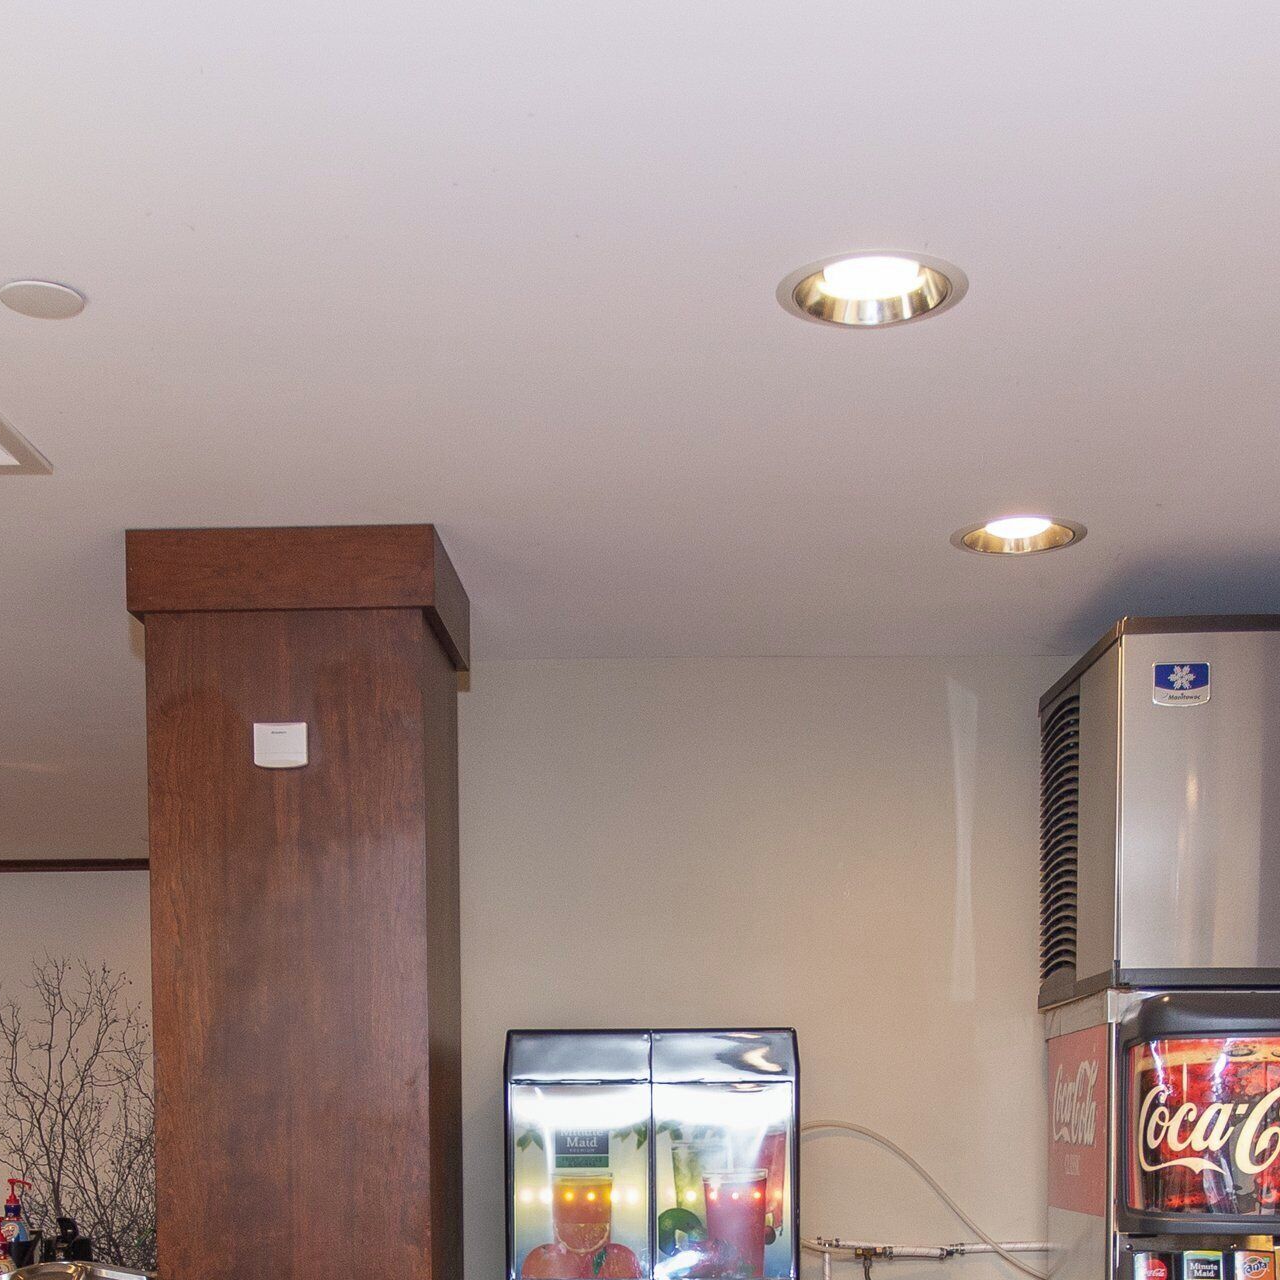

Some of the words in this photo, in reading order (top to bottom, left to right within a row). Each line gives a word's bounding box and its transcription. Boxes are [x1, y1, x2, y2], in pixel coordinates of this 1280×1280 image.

[1053, 1060, 1099, 1147] Coca-Cola
[566, 1136, 598, 1148] Maid
[1190, 1262, 1218, 1271] Minute
[1194, 1269, 1215, 1277] Maid
